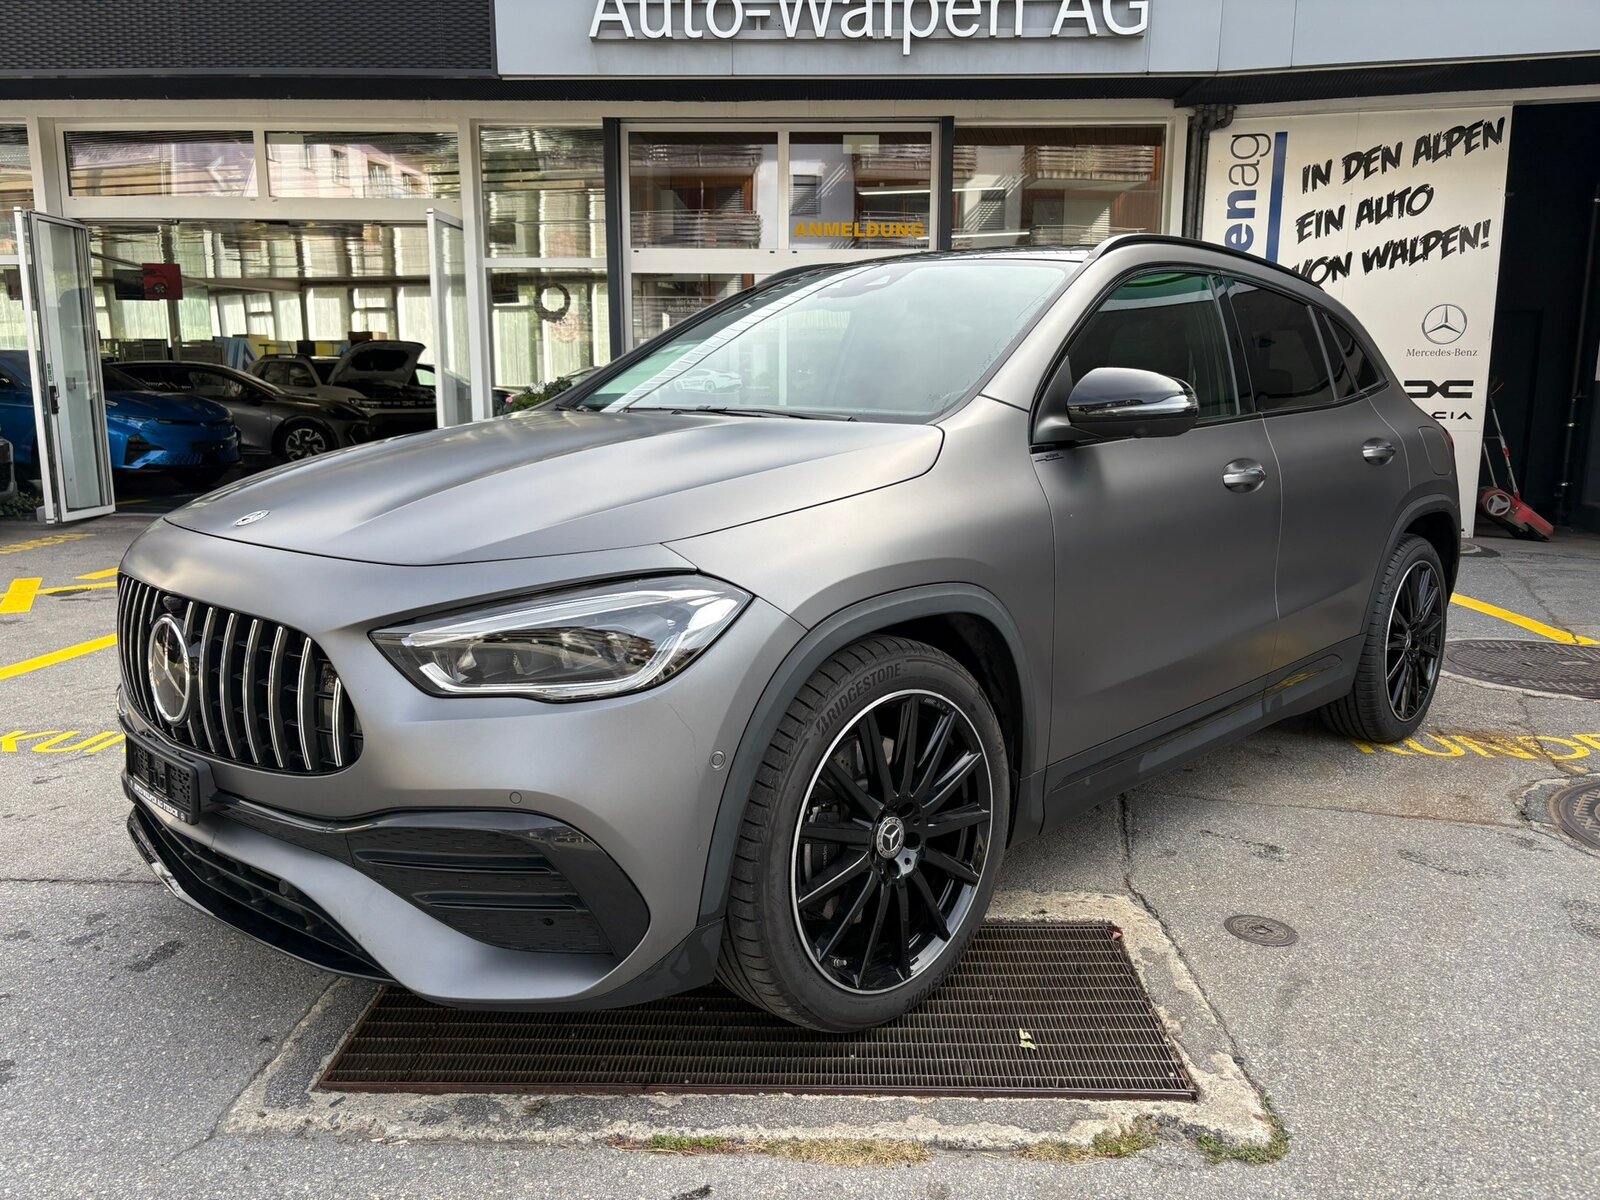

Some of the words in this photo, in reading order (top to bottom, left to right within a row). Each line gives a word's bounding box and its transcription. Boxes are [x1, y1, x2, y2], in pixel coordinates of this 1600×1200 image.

[589, 0, 1023, 55] Auto-Walpen
[1051, 0, 1148, 36] AG
[1302, 159, 1333, 194] IN
[1342, 141, 1403, 184] DEN
[1412, 117, 1505, 167] ALPEN
[795, 222, 925, 237] ANMELDUNG
[1295, 205, 1346, 245] EIN
[1355, 184, 1434, 230] AUTO
[1362, 219, 1492, 276] WALPEN!
[1406, 348, 1478, 357] Mercedes-Benz
[816, 662, 902, 737] BRIDGESTONE
